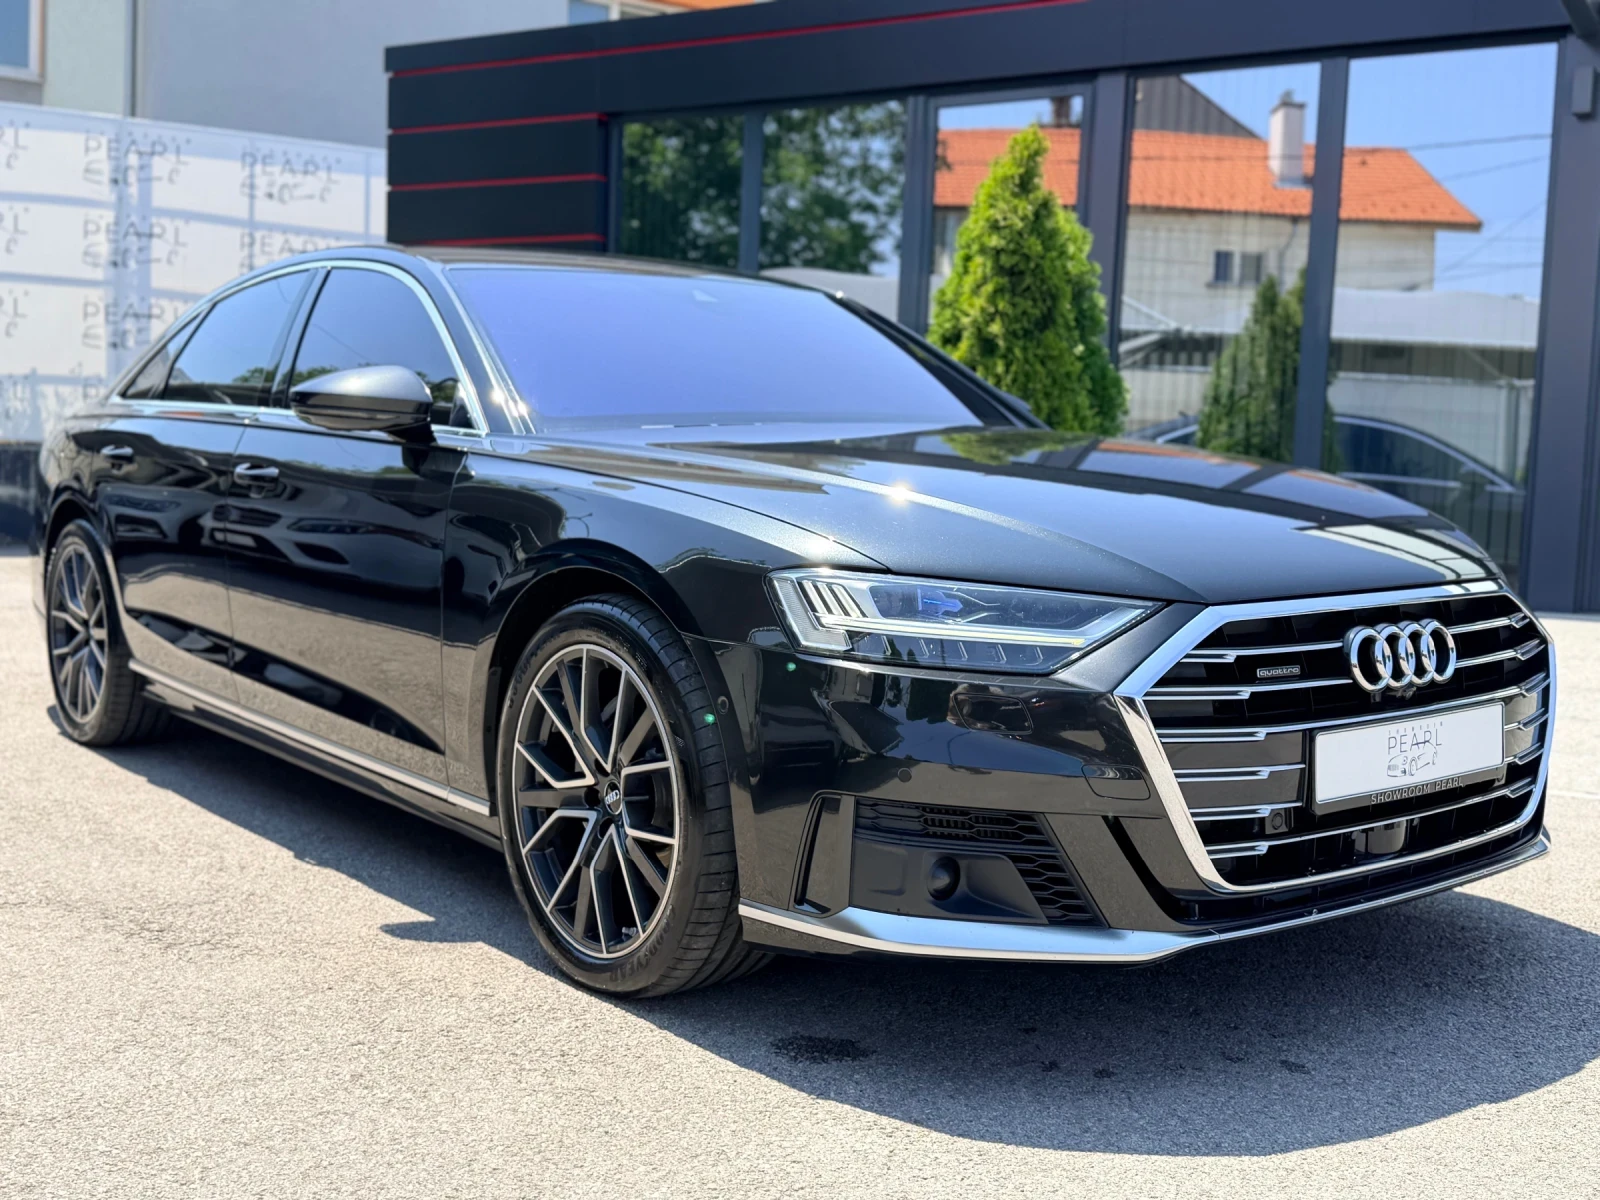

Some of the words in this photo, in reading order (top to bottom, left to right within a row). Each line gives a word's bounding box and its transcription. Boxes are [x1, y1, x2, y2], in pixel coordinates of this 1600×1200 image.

[241, 151, 340, 185] PEARL
[83, 219, 188, 248] PEARL
[1259, 667, 1299, 677] quattro
[1388, 728, 1442, 755] PEARL
[1371, 784, 1430, 804] SHOWROOM
[1435, 776, 1464, 791] PEARL
